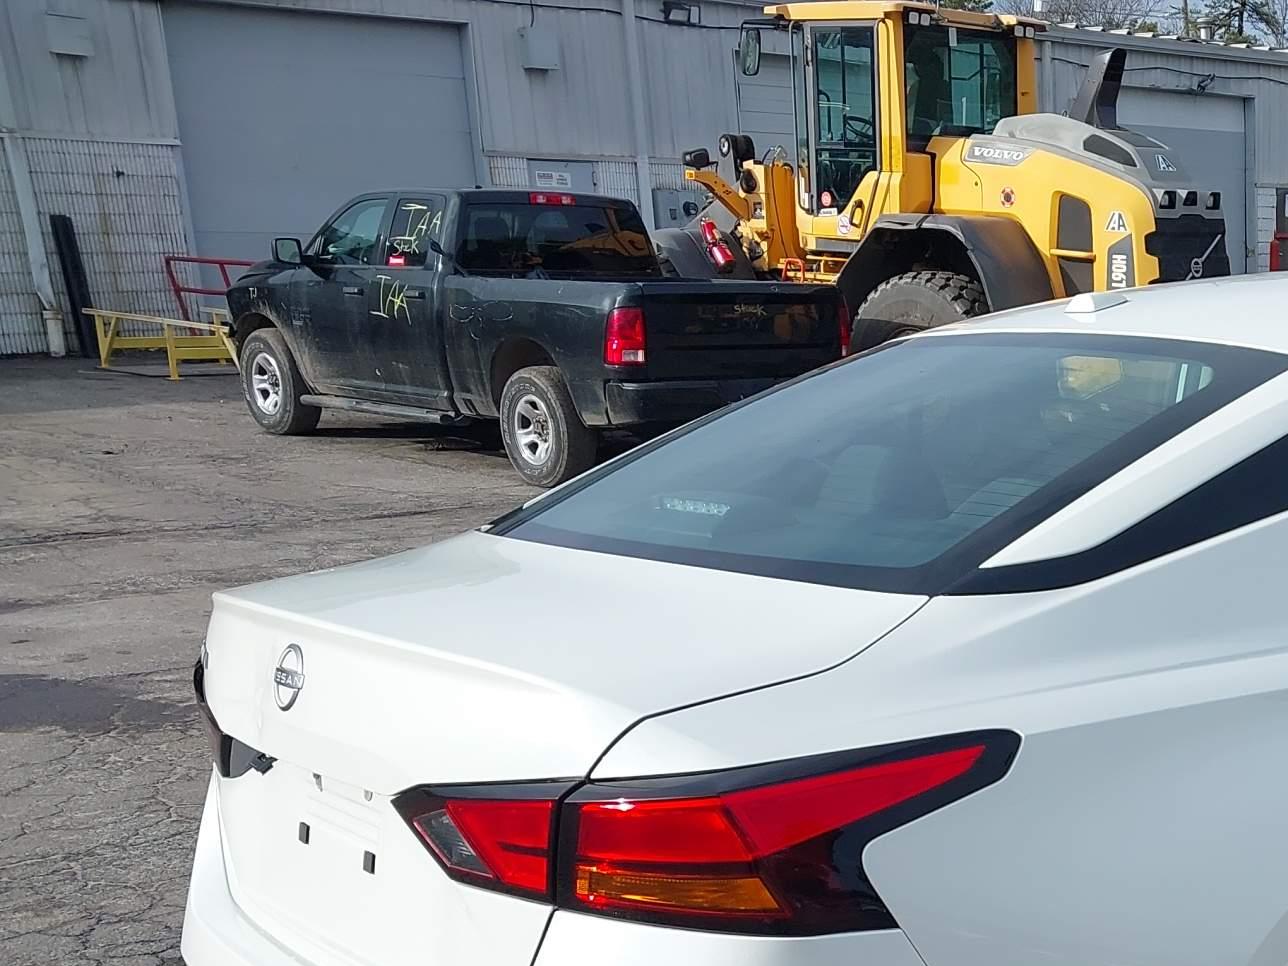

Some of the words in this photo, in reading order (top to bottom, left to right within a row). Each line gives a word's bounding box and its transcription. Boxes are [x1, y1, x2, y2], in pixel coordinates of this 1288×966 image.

[973, 146, 1025, 161] VOLVO
[389, 203, 442, 240] IAA
[1111, 254, 1128, 288] L90H
[275, 670, 304, 688] SSAN
